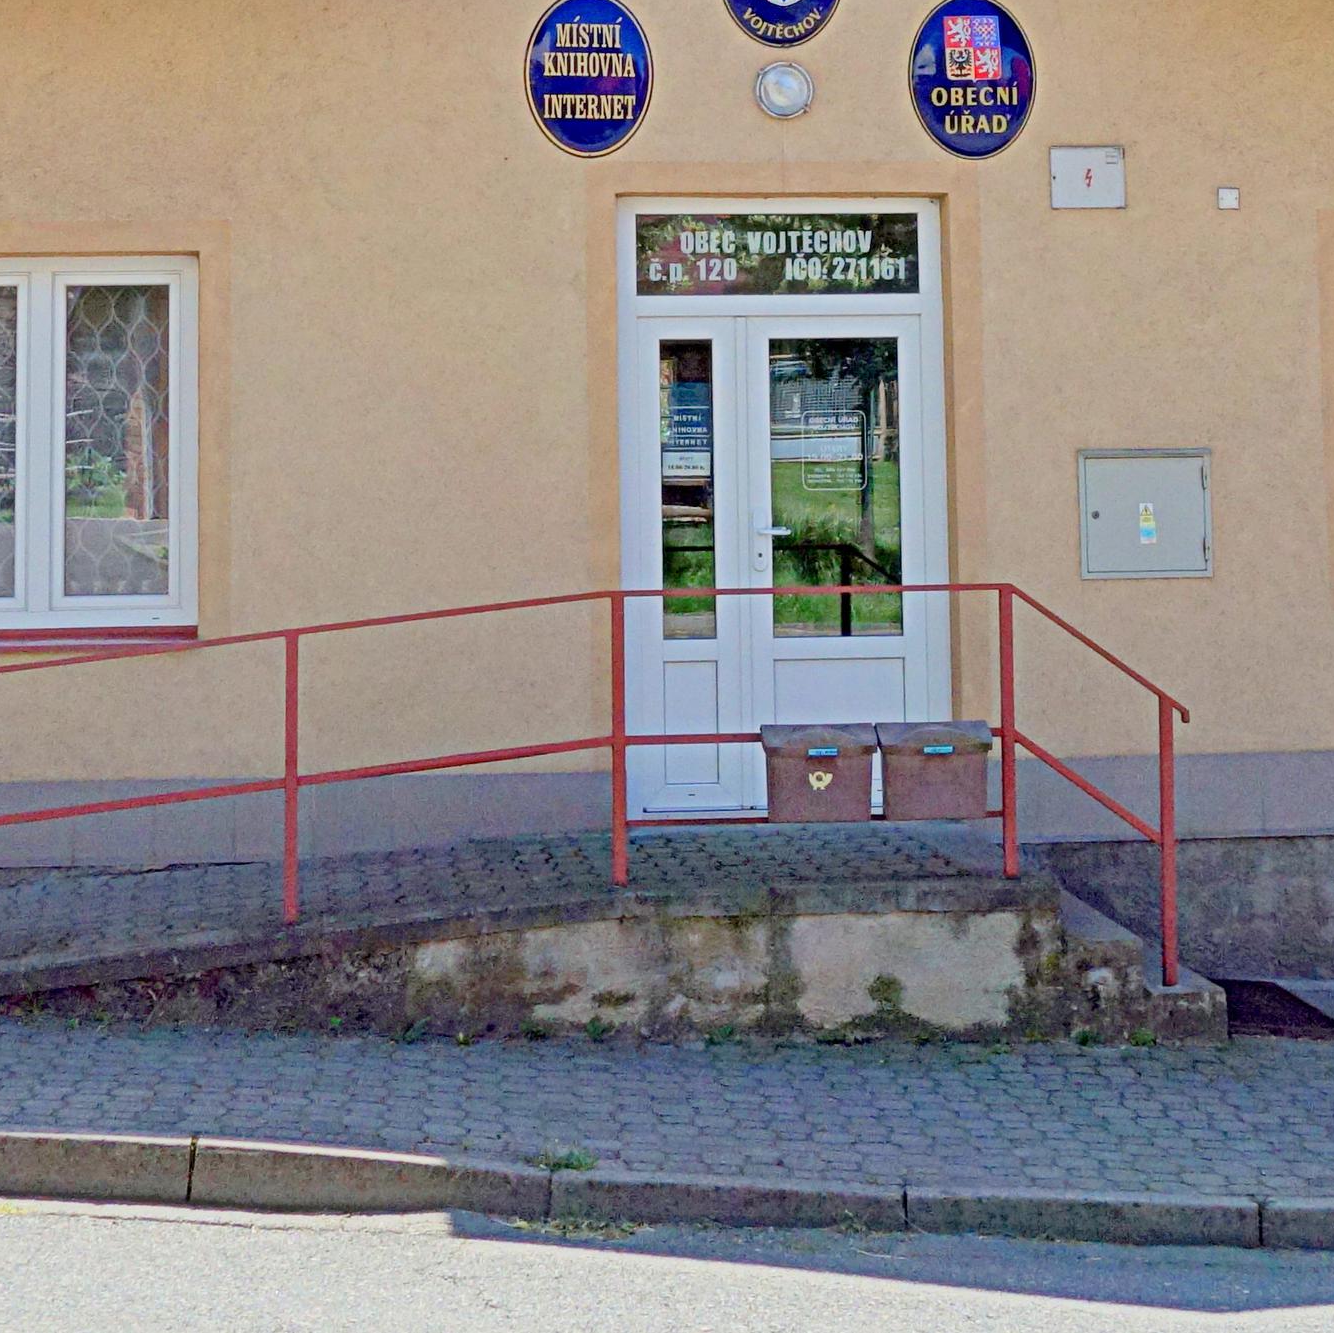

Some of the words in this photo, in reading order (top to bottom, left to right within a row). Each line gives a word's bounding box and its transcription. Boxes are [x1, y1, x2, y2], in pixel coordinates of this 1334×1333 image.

[555, 15, 622, 48] MÍSTNÍ
[742, 7, 821, 39] VOJTĚCHOV
[543, 52, 636, 77] KNIHOVNA
[543, 94, 636, 119] INTERNET
[931, 81, 1018, 107] OBECNÍ
[945, 109, 1008, 134] ÚŘAD
[680, 230, 736, 254] OBEC
[747, 228, 872, 254] VOJTĚCHOV
[696, 258, 737, 281] 120
[832, 256, 906, 280] 271161
